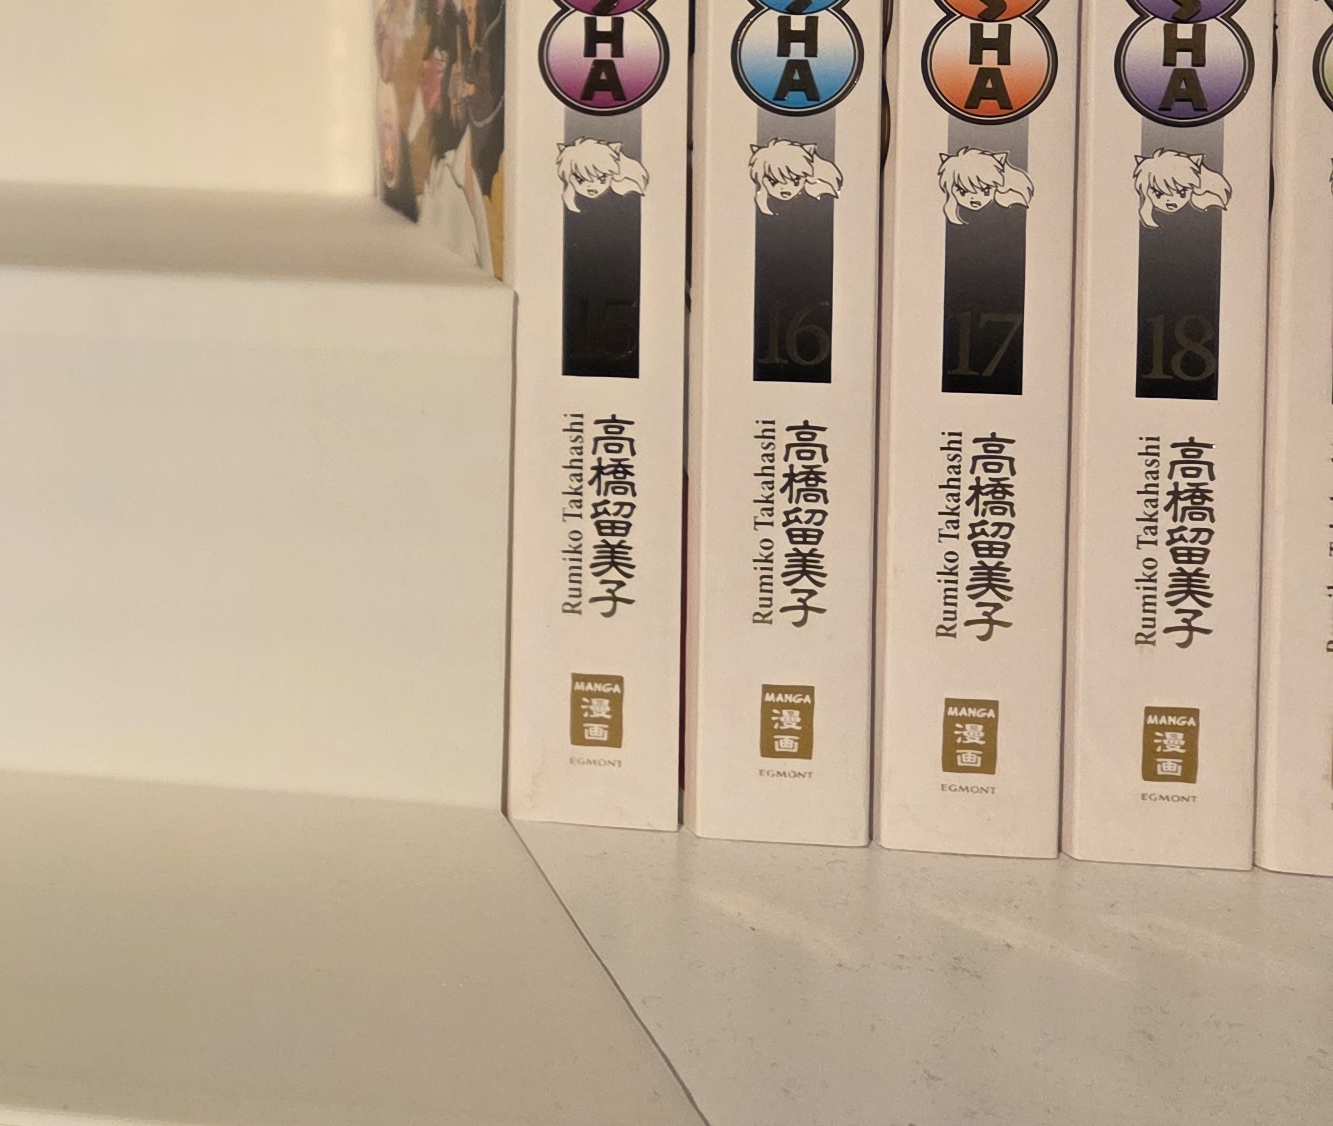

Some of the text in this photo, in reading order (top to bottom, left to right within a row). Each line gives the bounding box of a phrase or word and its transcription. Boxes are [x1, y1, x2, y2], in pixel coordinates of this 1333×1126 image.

[761, 300, 829, 366] 16
[947, 312, 1023, 377] 17
[1141, 312, 1217, 381] 18
[562, 414, 584, 615] Rumiko Takahashi
[588, 414, 637, 617] 高橋留美子
[753, 420, 775, 624] Rumiko Takahashi
[780, 420, 829, 627] 高橋留美子
[936, 432, 962, 638] Rumiko Takahashi
[964, 432, 1016, 641] 高橋留美子
[1135, 437, 1160, 646] Rumiko Takahashi
[1163, 436, 1215, 648] 高橋留美子
[573, 681, 622, 694] MANGA
[765, 693, 811, 703] MANGA
[948, 707, 995, 718] MANGA
[1147, 715, 1196, 726] MANGA
[569, 756, 622, 767] EGMONT
[759, 769, 813, 778] EGMONT
[941, 784, 995, 795] EGMONT
[1141, 793, 1197, 803] EGMONT
